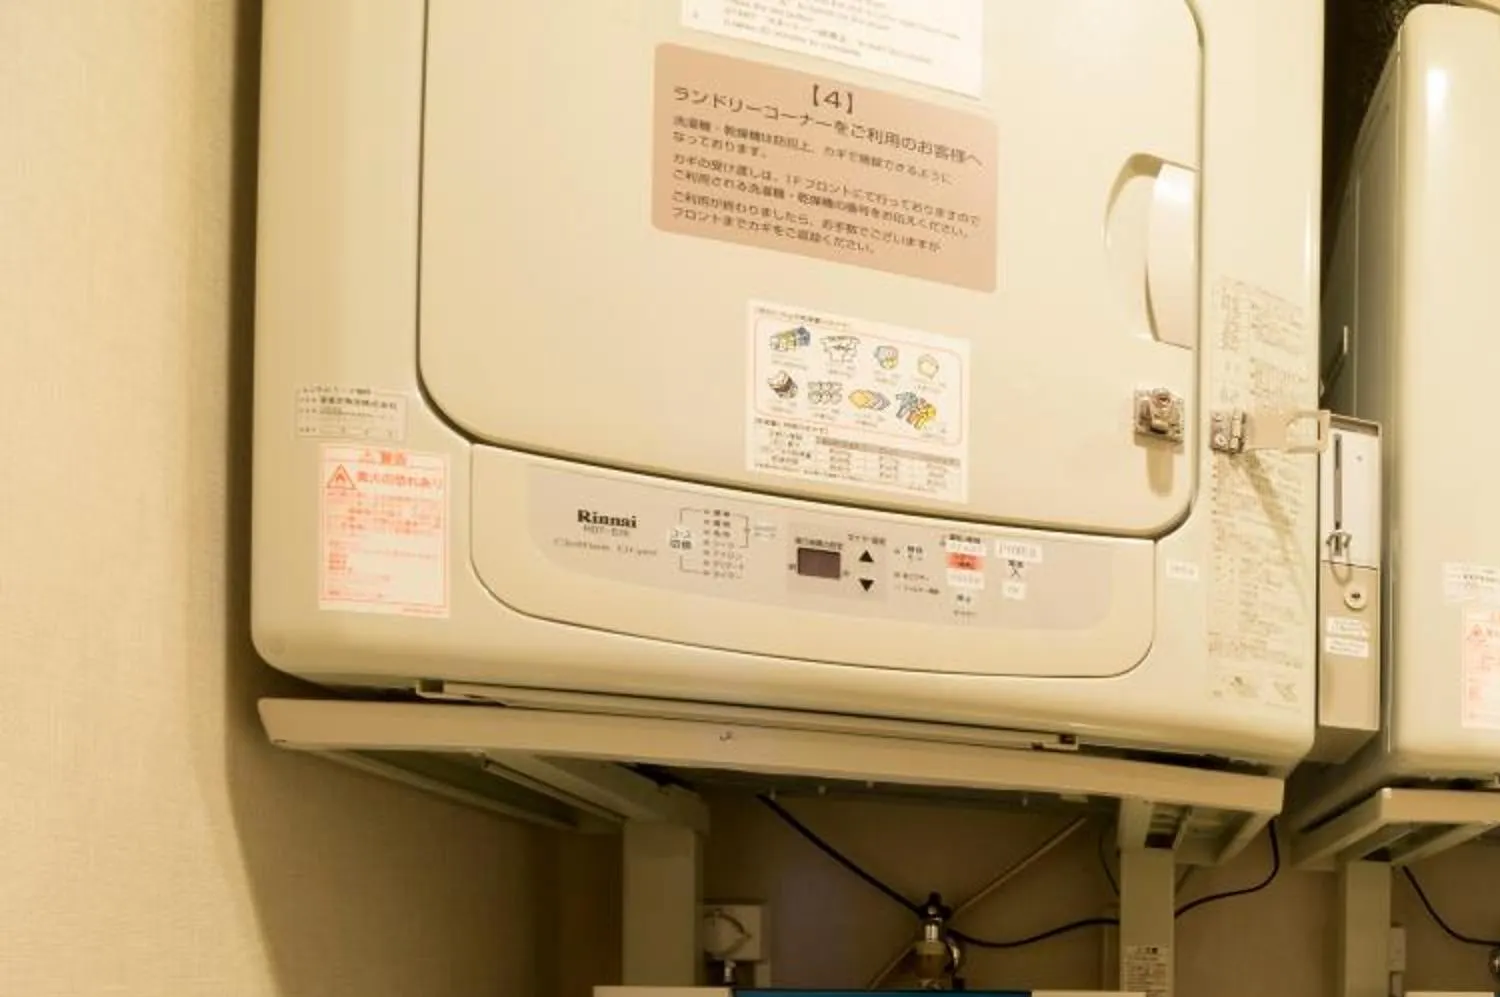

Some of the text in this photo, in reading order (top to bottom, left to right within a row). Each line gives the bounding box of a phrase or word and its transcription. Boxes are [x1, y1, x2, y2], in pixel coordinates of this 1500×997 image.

[673, 86, 983, 167] ランドリーコーナーをご利用のお客様へ
[577, 509, 637, 528] Rinnai
